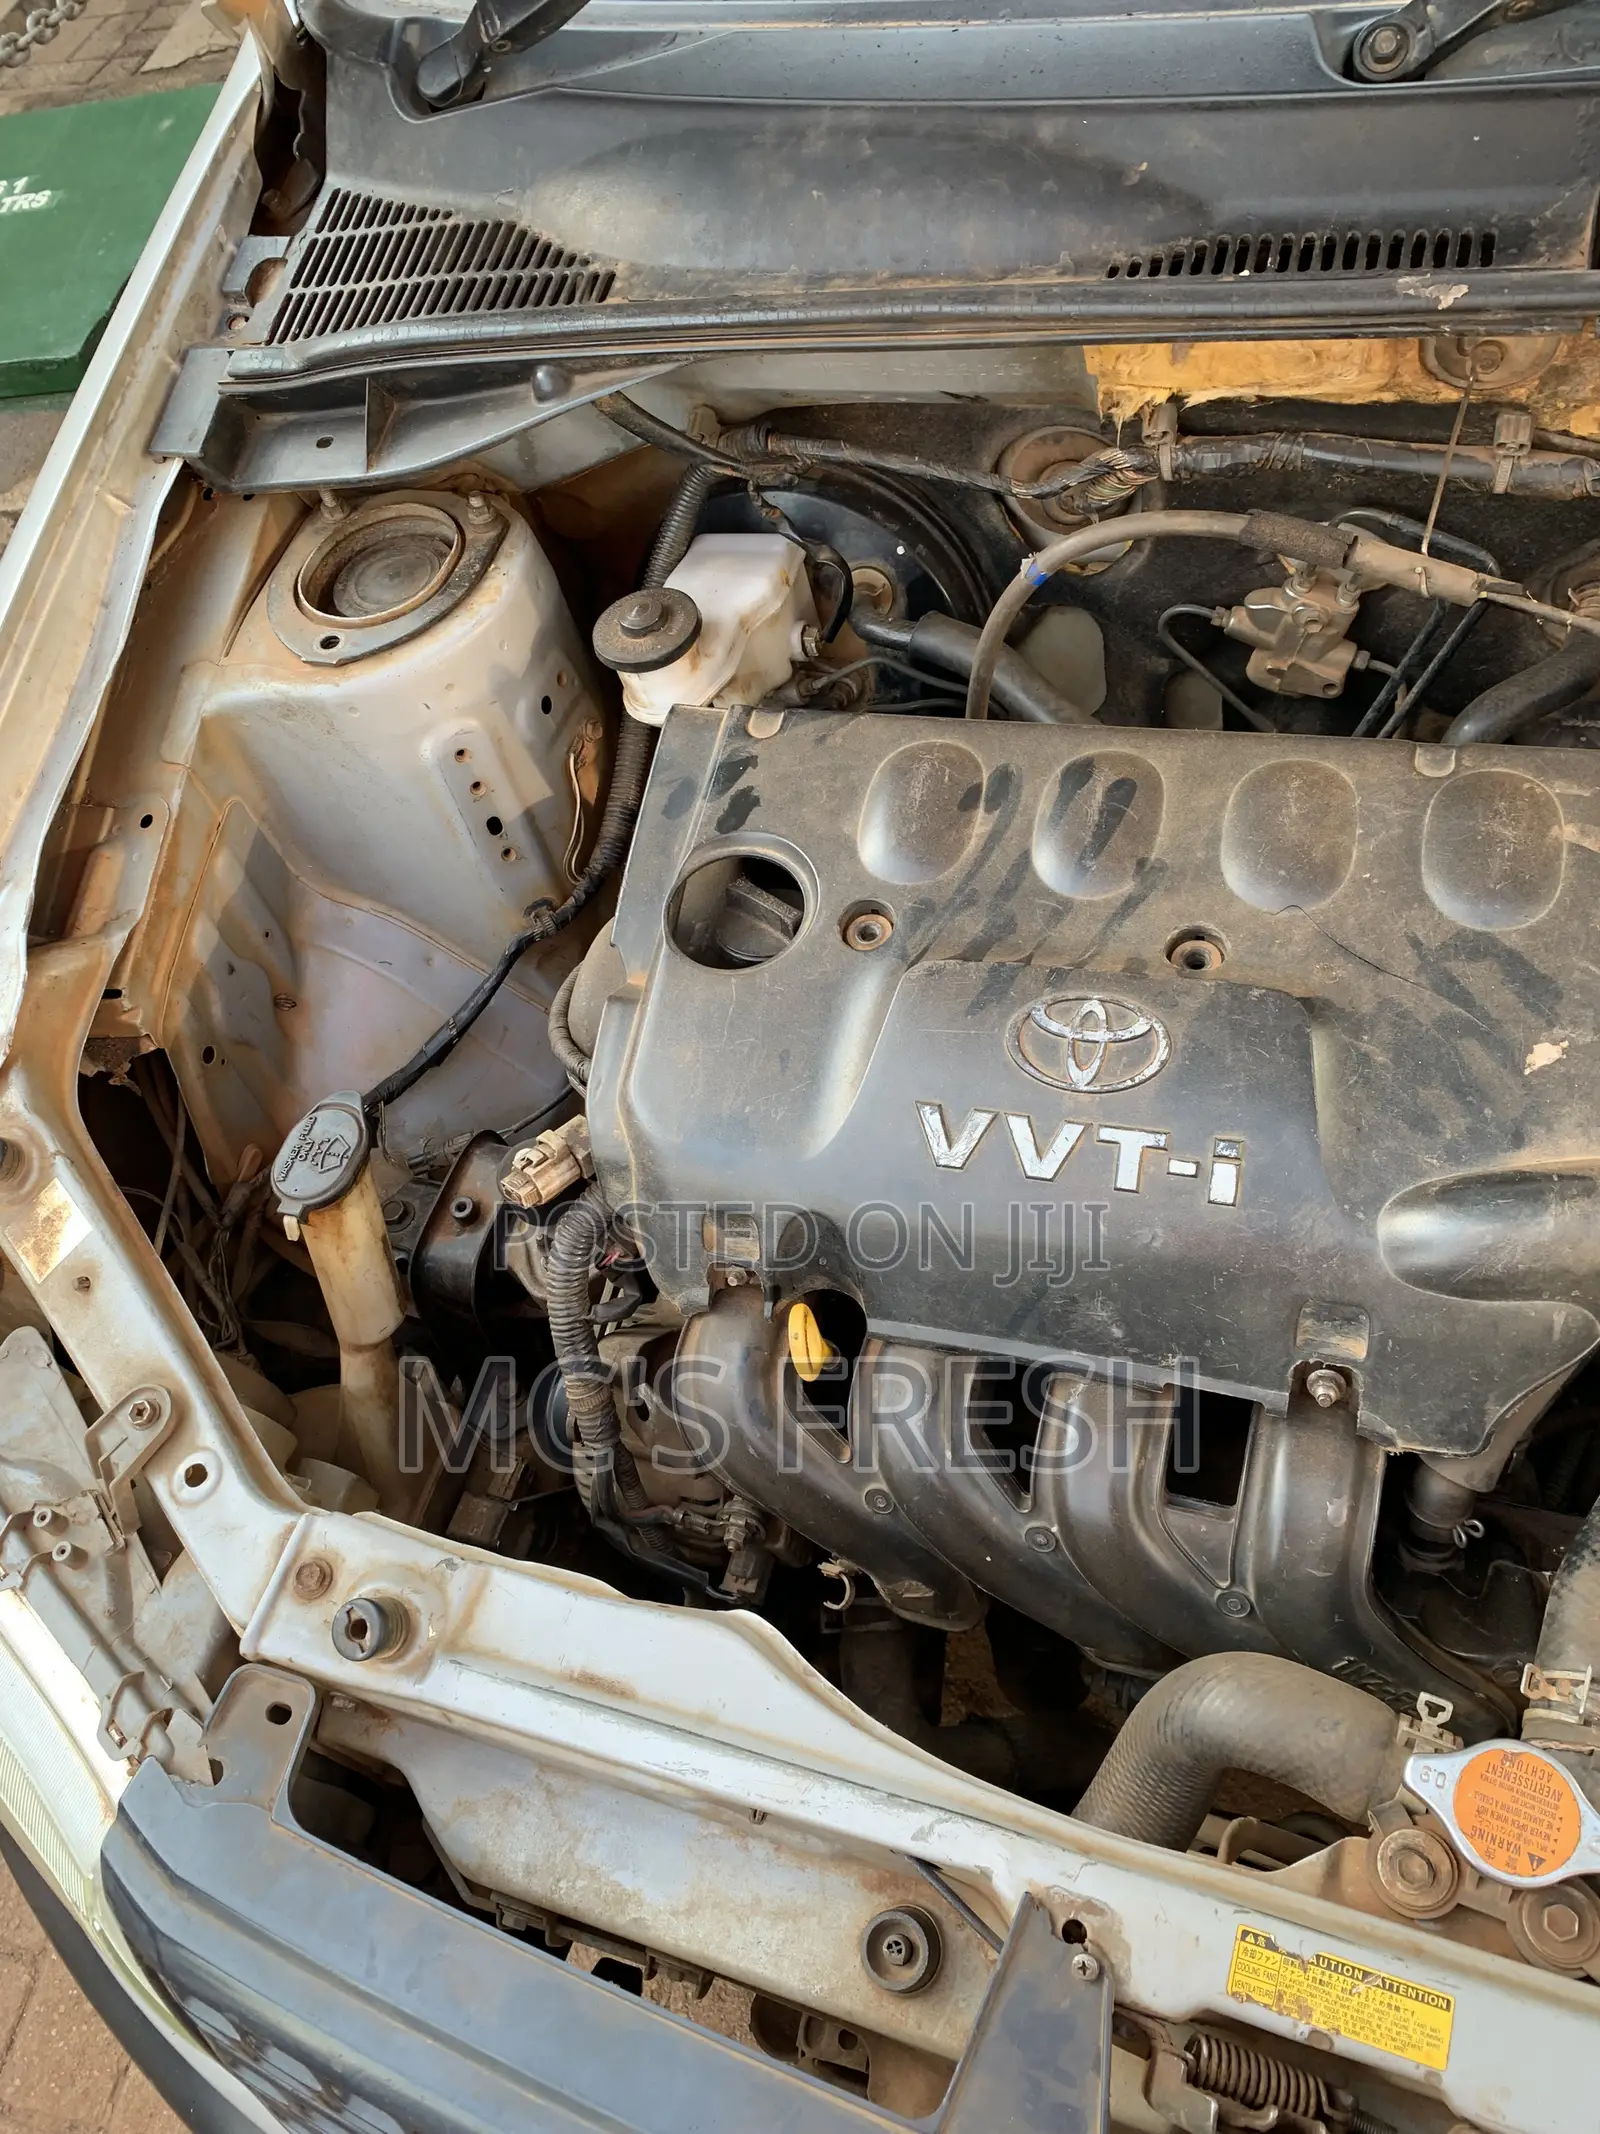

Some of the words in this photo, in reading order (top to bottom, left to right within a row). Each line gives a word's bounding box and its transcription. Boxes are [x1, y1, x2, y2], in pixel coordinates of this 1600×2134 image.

[275, 1144, 302, 1183] WASHER
[298, 1115, 317, 1141] FLUID
[298, 1139, 315, 1161] ONLY
[914, 1099, 1245, 1208] VVT-i
[1484, 1760, 1564, 1803] AVERTISSEMENT
[1488, 1809, 1511, 1825] WHEN
[1509, 1818, 1529, 1832] OPEN
[1468, 1824, 1524, 1856] WARNING
[1528, 1826, 1552, 1842] NEVER
[1236, 1960, 1261, 1977] COOLING
[1262, 1969, 1277, 1983] FANS
[1308, 1952, 1363, 1980] AUTION
[1374, 1975, 1447, 2009] ATTENTION
[1233, 1978, 1274, 2000] VENTILATEURS
